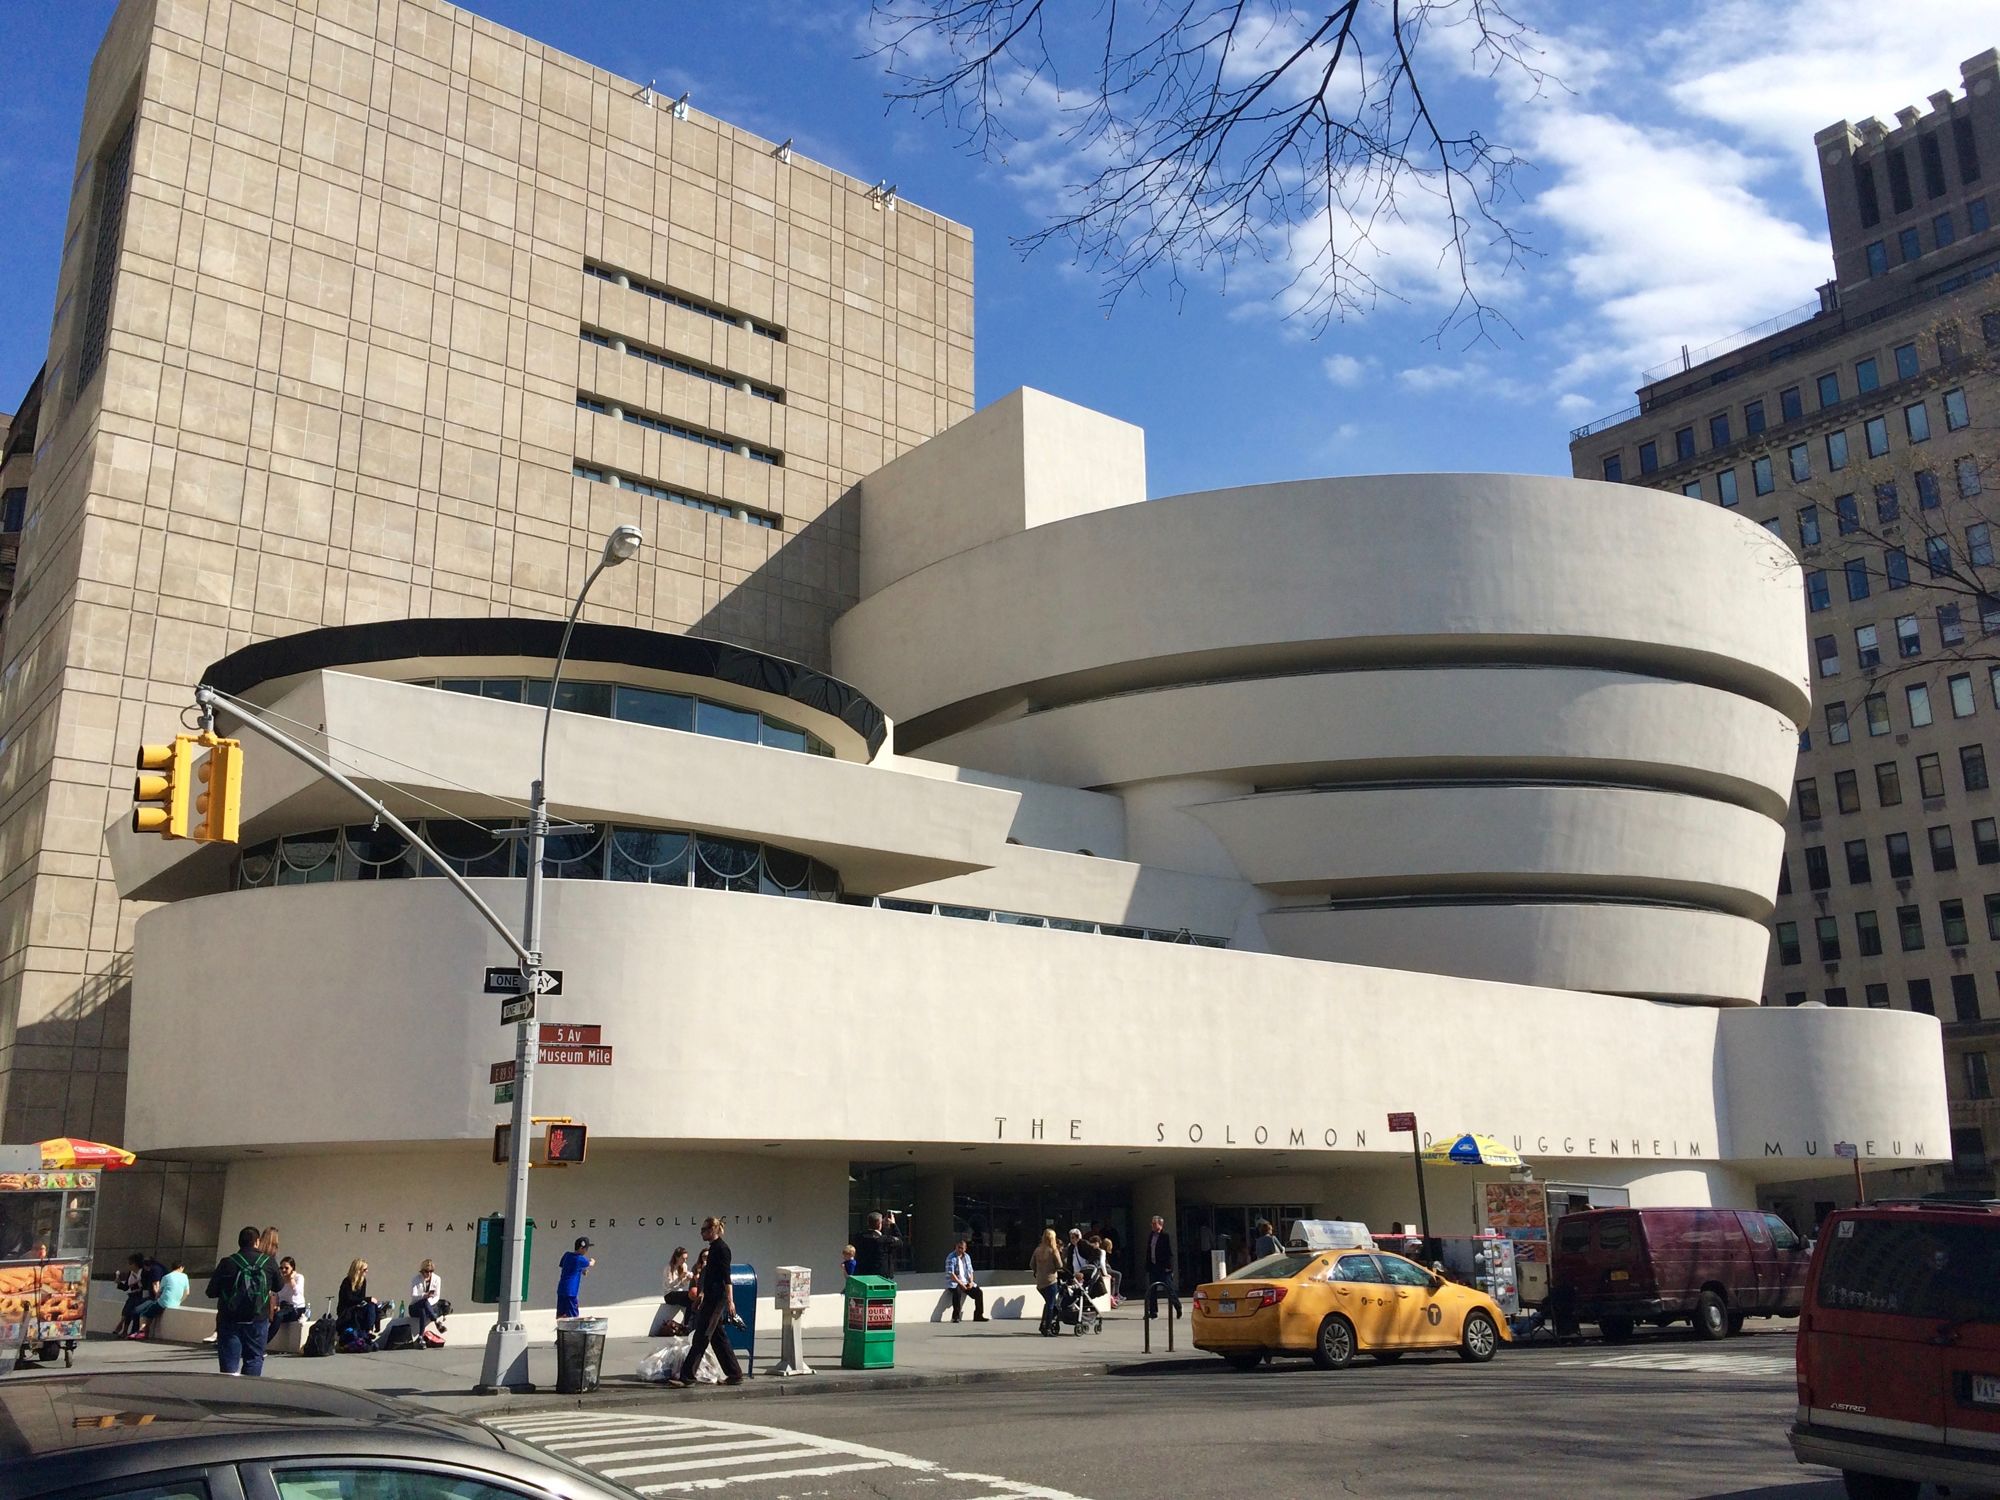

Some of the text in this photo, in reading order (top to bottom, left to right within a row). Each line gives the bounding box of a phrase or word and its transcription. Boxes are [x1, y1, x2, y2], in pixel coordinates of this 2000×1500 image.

[496, 975, 552, 988] ONE AY
[505, 1001, 530, 1017] ONE WAY
[557, 1028, 581, 1042] 5 Av
[538, 1048, 611, 1063] Museum Mile
[995, 1117, 1082, 1141] THE
[1157, 1122, 1366, 1148] SOLOMON
[1488, 1133, 1701, 1157] UGGENHEIM
[1764, 1140, 1926, 1157] MUEUM
[344, 1215, 773, 1233] THE THANUSER COLLCTION
[1830, 1402, 1867, 1413] ASTRO
